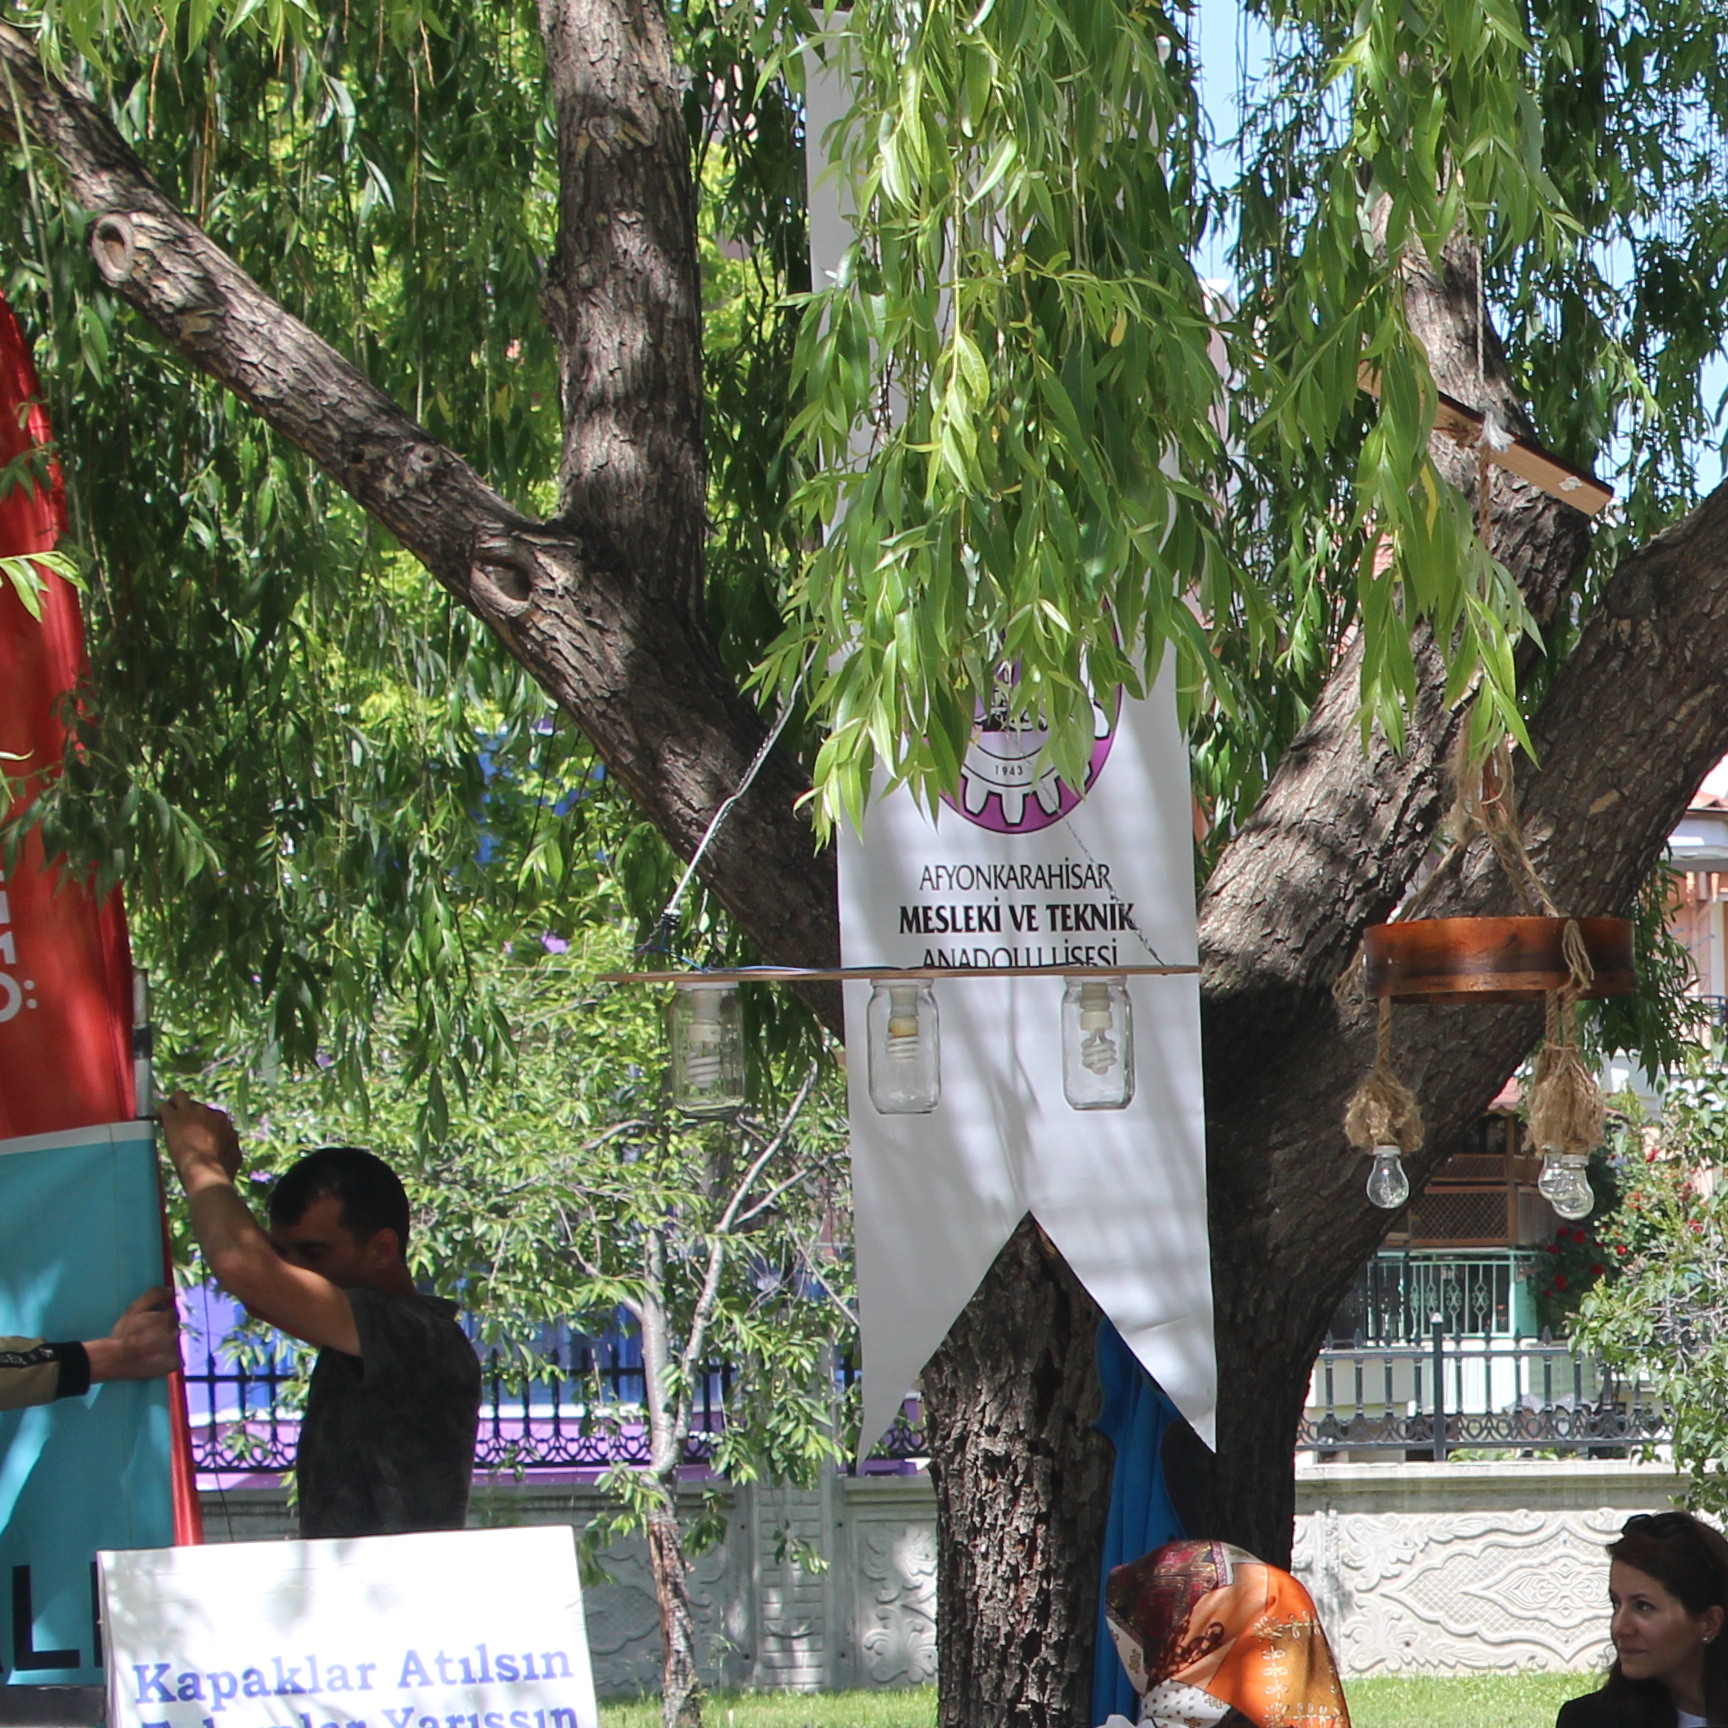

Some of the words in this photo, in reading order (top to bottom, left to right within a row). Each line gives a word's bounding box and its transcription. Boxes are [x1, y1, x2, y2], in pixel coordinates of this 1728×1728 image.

[995, 765, 1024, 777] 1943
[919, 857, 1110, 891] AFYONKARAHİSAR
[900, 896, 1001, 934] MESLEKİ
[1008, 904, 1039, 932] VE
[1046, 895, 1137, 932] TEKNİK
[132, 1654, 376, 1712] Kapaklar
[397, 1643, 574, 1688] Atılsın
